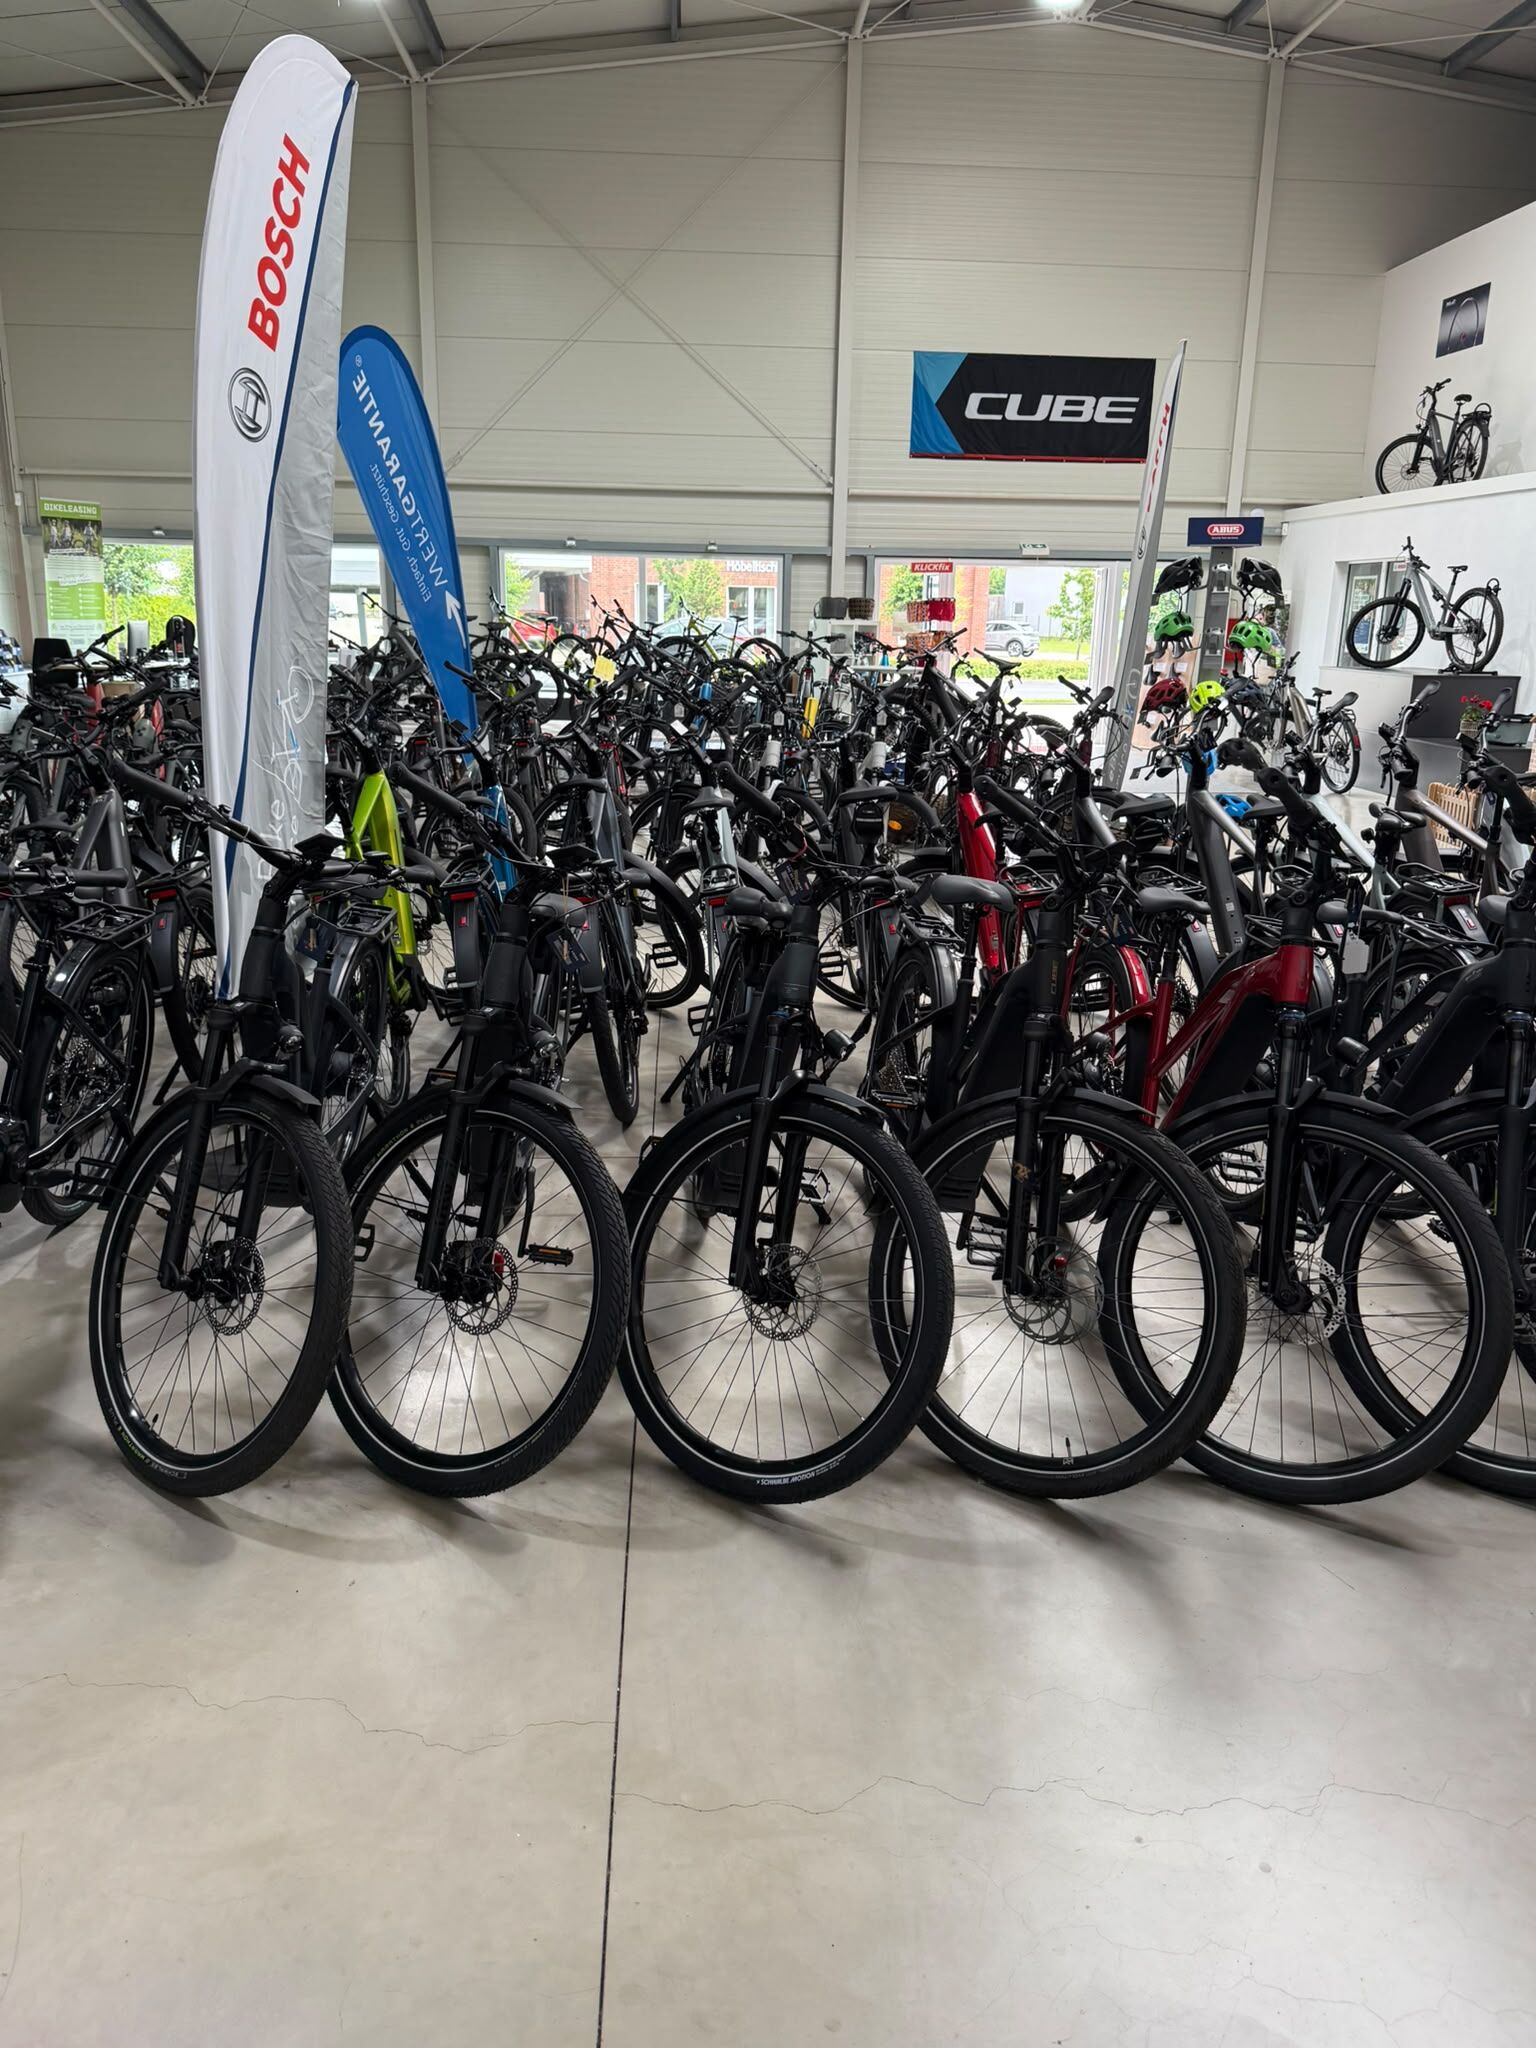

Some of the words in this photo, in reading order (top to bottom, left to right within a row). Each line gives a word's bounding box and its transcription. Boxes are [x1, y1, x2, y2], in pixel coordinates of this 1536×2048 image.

[248, 132, 310, 353] BOSCH
[964, 392, 1140, 424] CUBE
[44, 503, 97, 515] BIKELEASING
[914, 563, 951, 572] KLICKfix
